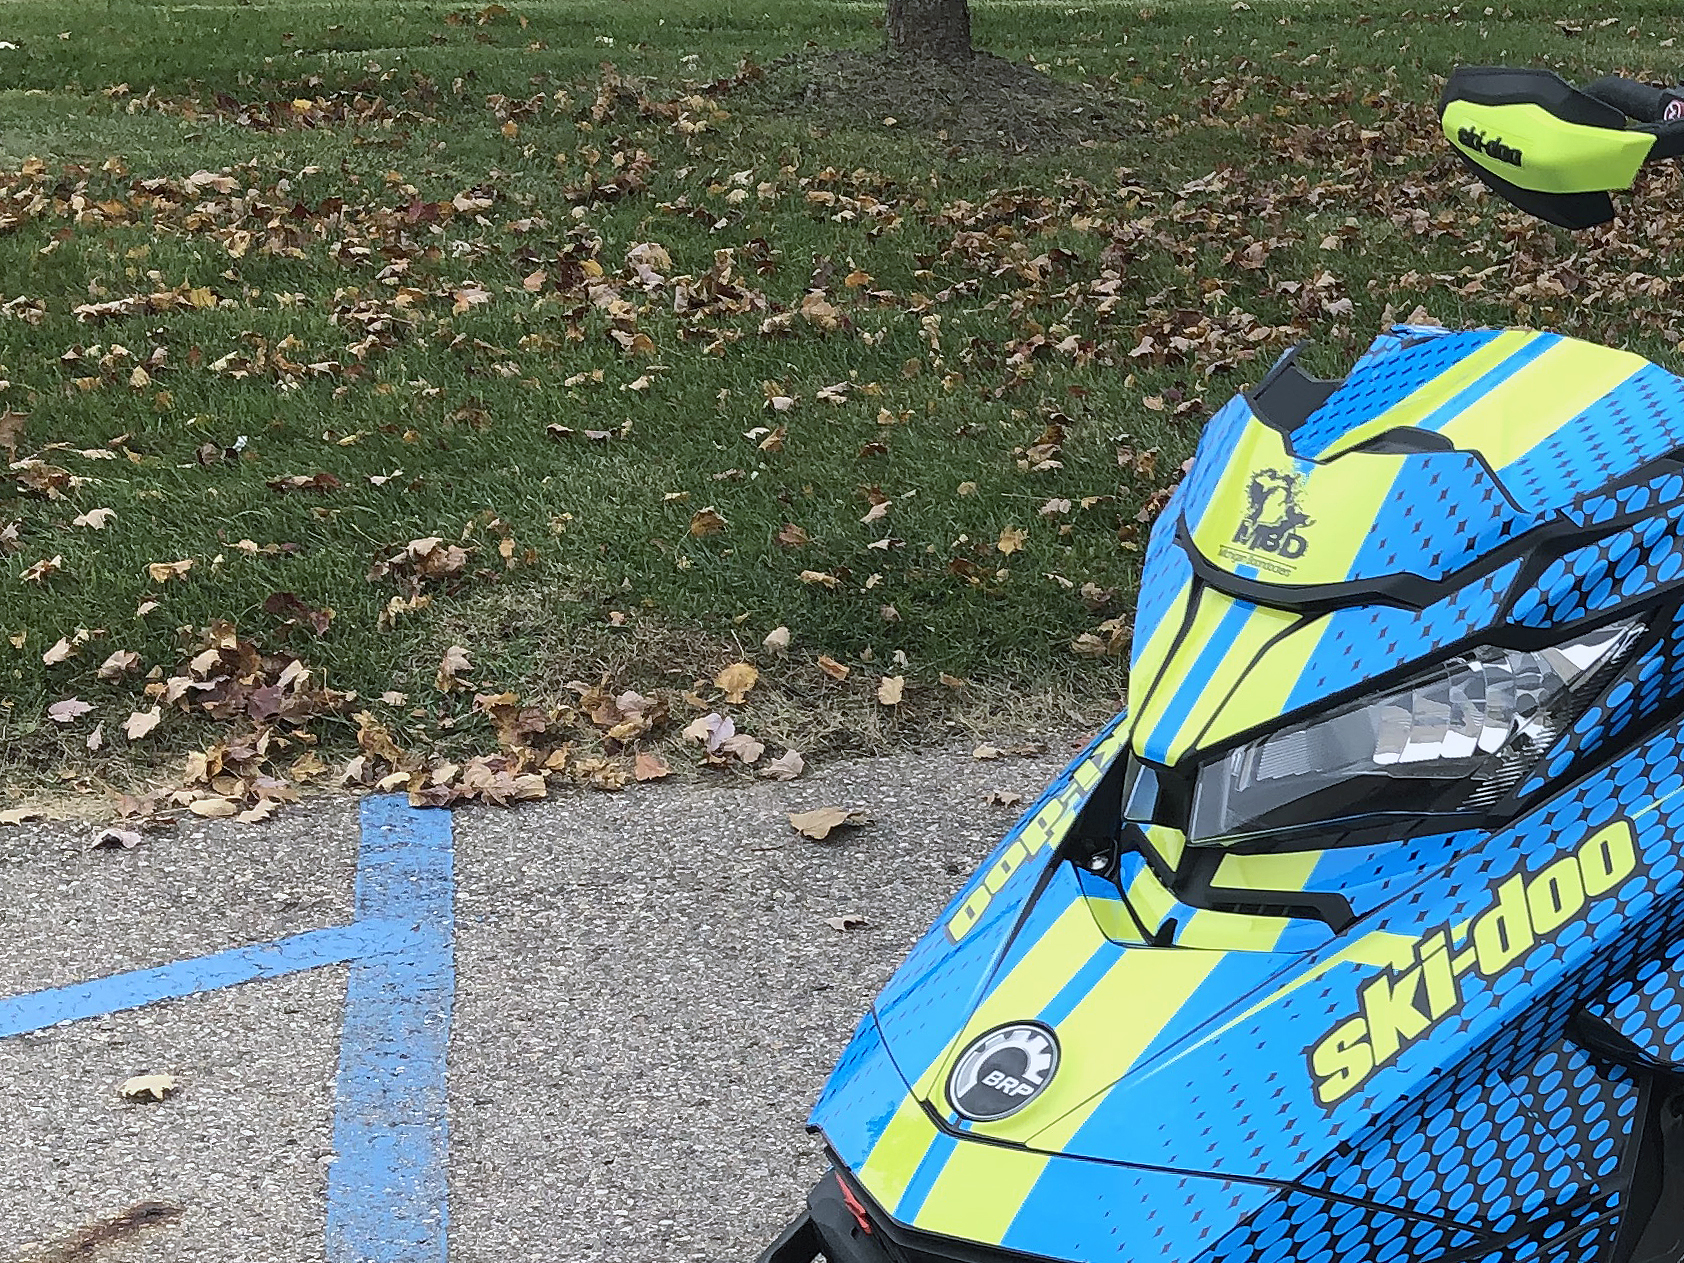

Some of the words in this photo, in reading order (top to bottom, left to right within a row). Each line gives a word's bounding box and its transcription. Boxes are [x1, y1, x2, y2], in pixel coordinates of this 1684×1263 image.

[1457, 125, 1522, 168] ski-doo
[1311, 819, 1638, 1104] ski-doo
[981, 1069, 1036, 1098] BRP
